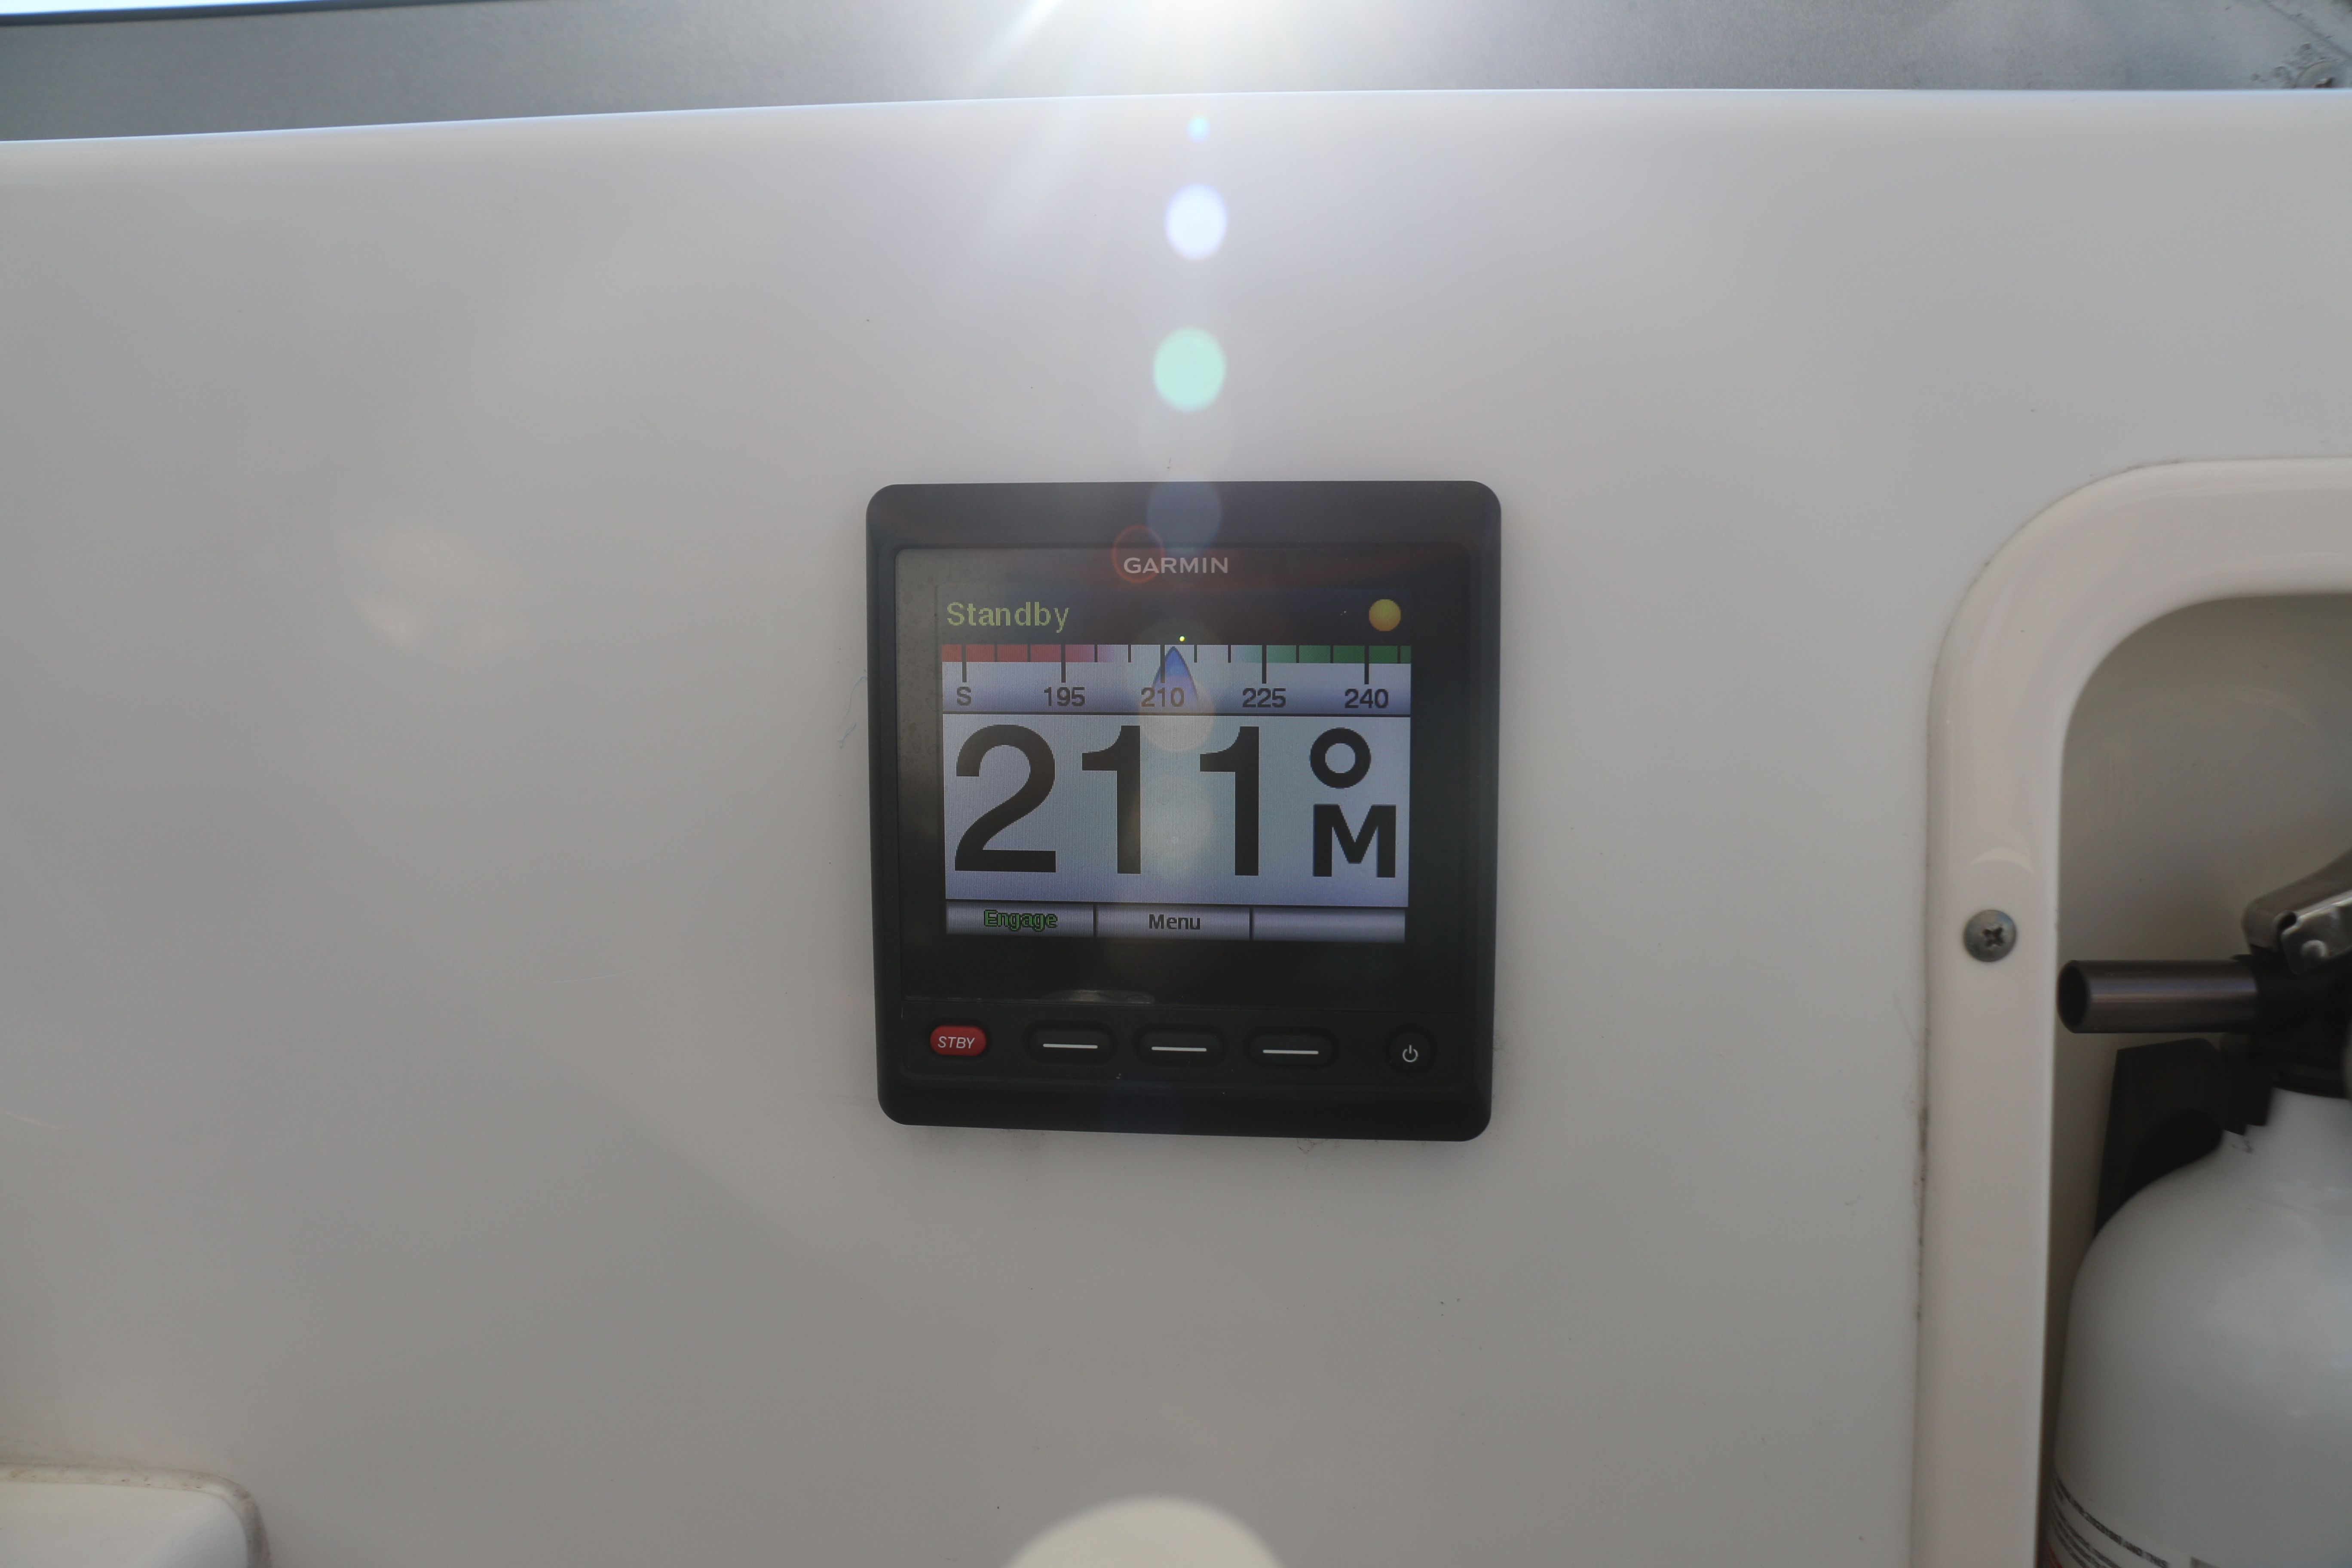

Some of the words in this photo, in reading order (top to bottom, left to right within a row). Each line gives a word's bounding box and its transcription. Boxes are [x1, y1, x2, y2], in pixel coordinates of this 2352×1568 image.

[1124, 557, 1228, 574] GARMIN
[946, 602, 1069, 633] Standby
[956, 686, 971, 706] S
[1044, 687, 1085, 707] 195
[1141, 687, 1185, 707] 210
[1242, 688, 1286, 708] 225
[1345, 689, 1389, 709] 240
[983, 910, 1058, 931] Engage
[1149, 914, 1201, 930] Menu
[937, 1036, 975, 1049] STBY
